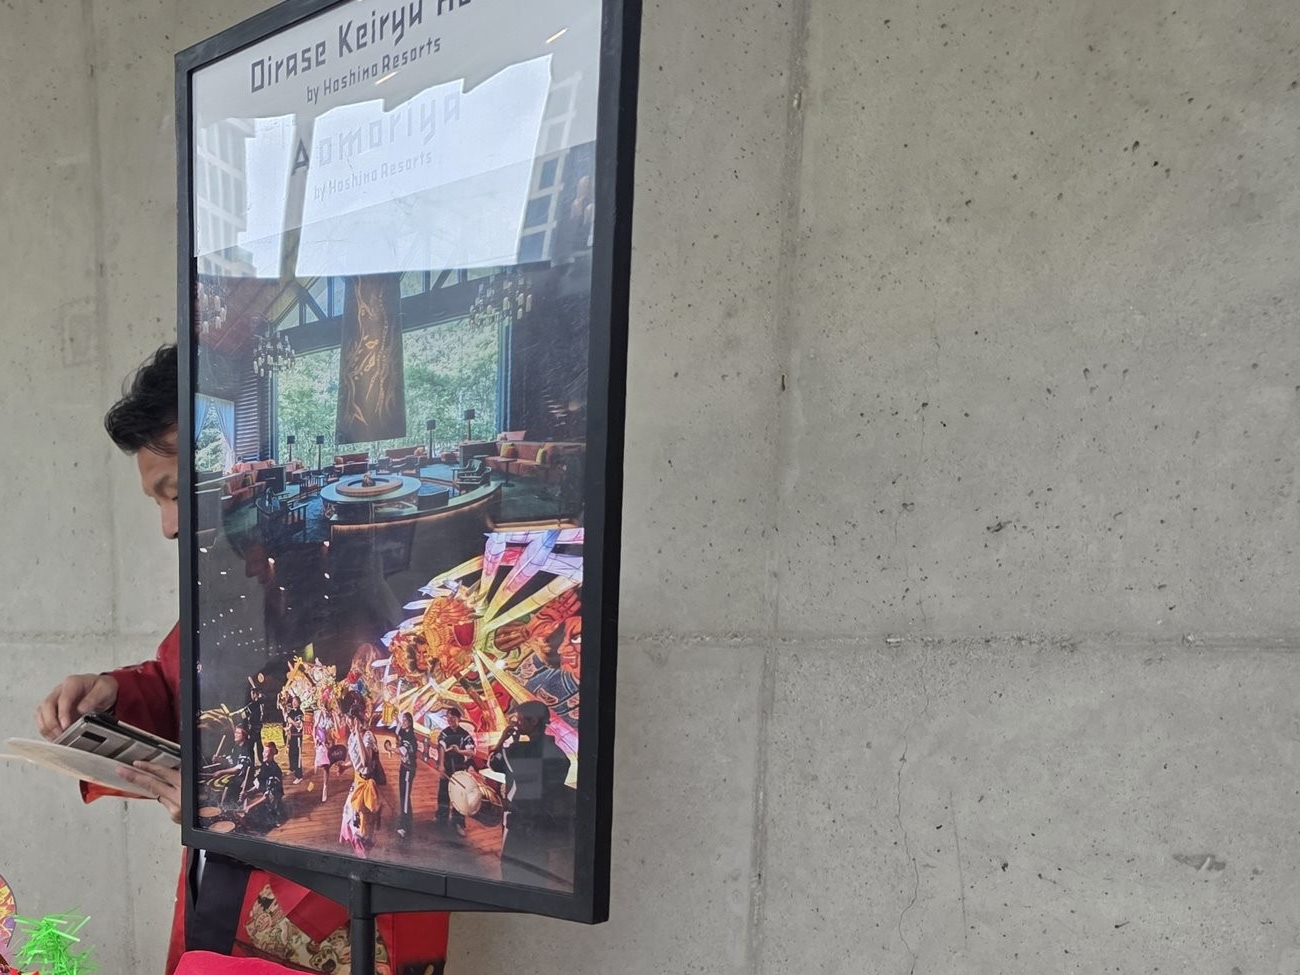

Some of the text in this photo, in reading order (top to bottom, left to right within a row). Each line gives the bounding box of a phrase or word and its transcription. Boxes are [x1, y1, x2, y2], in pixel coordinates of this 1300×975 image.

[251, 0, 423, 93] Oirase Keiryu
[306, 36, 441, 105] by Hoshino Resorts
[291, 91, 461, 176] Aomoriya
[314, 151, 432, 201] by Hoshino Resorts
